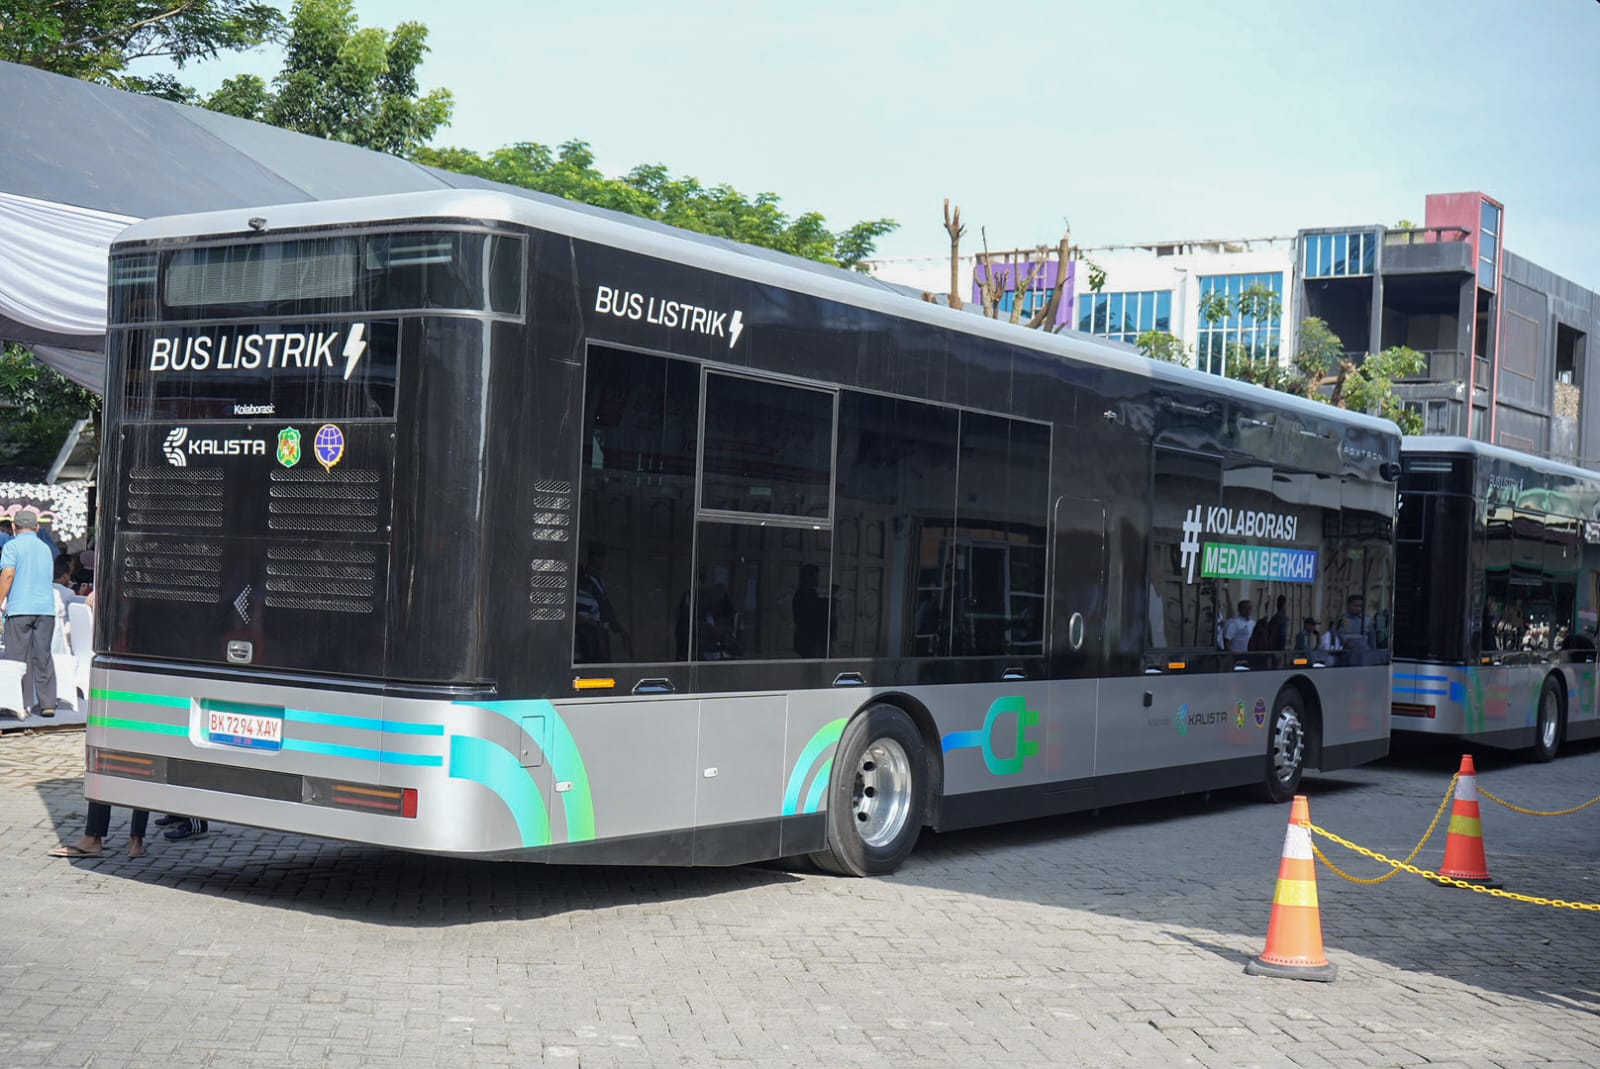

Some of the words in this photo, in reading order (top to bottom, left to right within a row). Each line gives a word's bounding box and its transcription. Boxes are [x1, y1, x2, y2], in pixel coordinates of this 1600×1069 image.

[595, 285, 643, 320] BUS
[647, 297, 727, 337] LISTRIK
[150, 335, 213, 371] BUS
[217, 331, 339, 369] LISTRIK
[188, 439, 266, 455] KALISTA
[1206, 506, 1297, 541] KOLABORASI
[1204, 546, 1257, 576] MEDAN
[1260, 551, 1314, 579] BERKAH
[211, 713, 224, 732] BK
[227, 716, 253, 736] 7294
[257, 719, 278, 737] XAY
[1188, 711, 1228, 726] KALISTA
